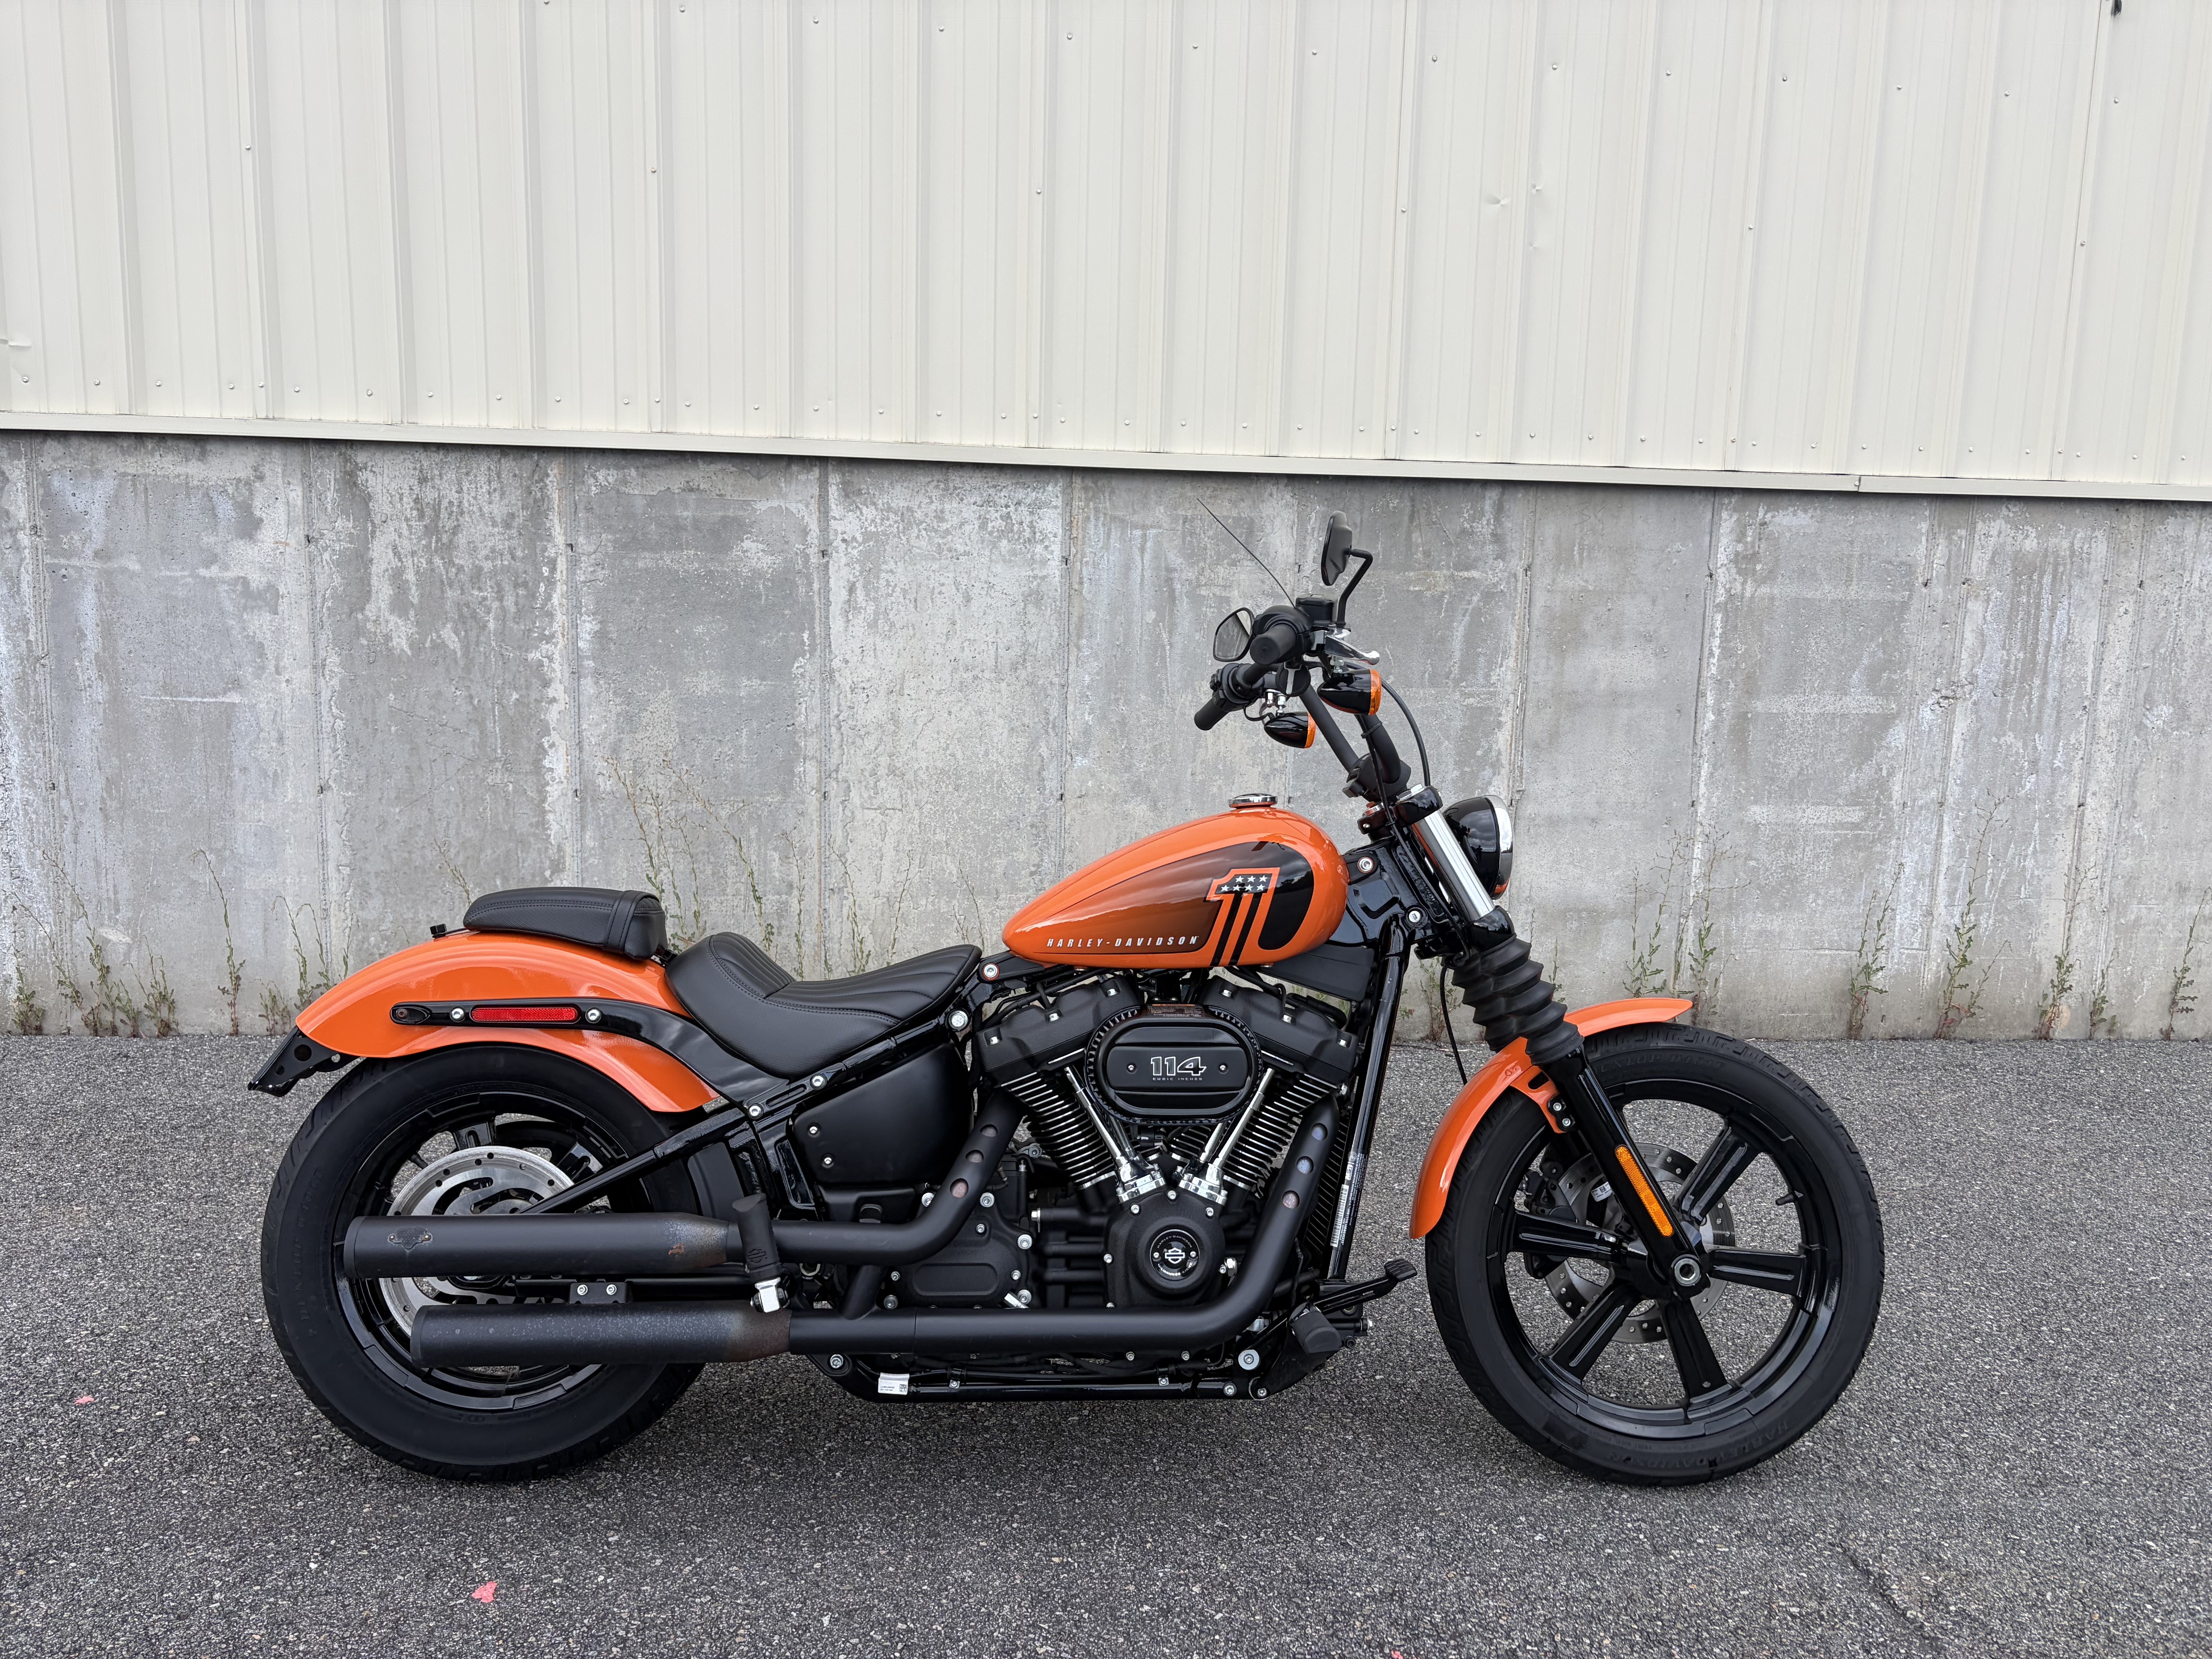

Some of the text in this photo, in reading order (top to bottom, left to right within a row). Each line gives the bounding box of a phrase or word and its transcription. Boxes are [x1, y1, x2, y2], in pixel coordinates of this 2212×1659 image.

[1047, 935, 1198, 948] HARLEY-DAVIDSON
[1151, 1056, 1207, 1076] 114
[1157, 1235, 1192, 1249] HARLEY-DAVIDSON
